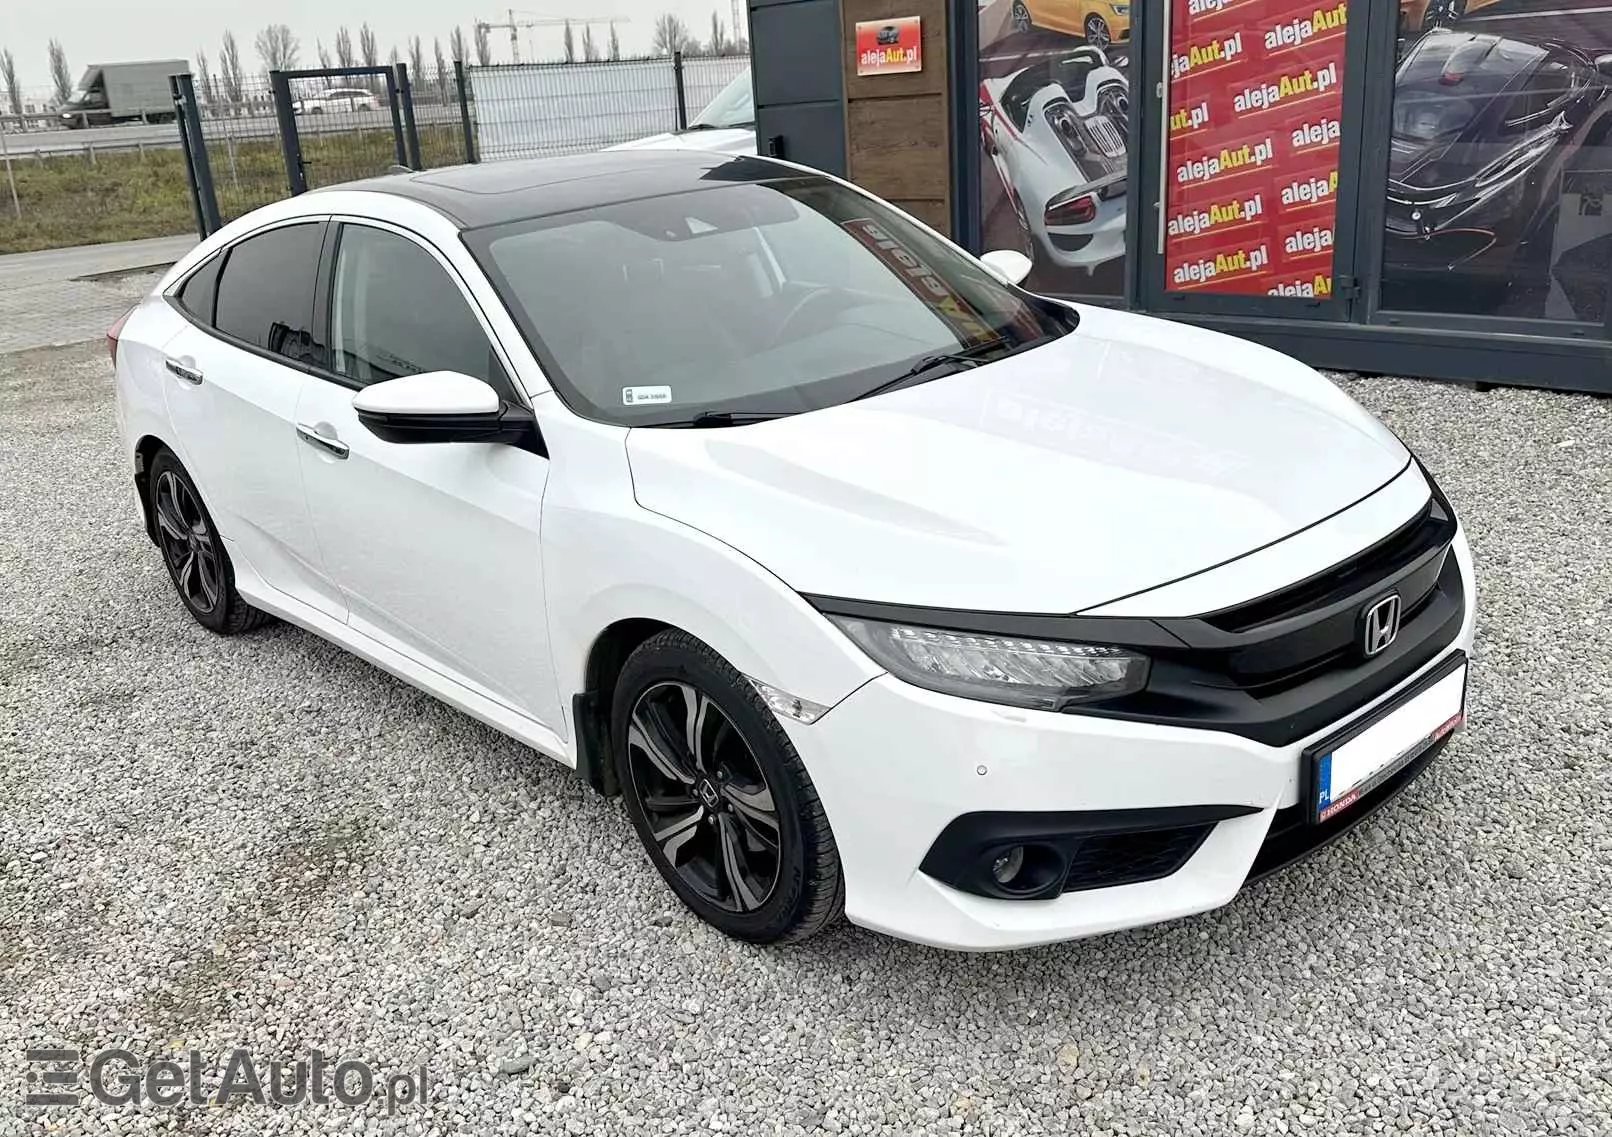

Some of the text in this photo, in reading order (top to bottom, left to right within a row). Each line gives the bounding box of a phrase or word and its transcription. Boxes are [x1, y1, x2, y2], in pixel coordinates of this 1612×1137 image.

[861, 46, 918, 67] alejaAut.pl
[1233, 63, 1337, 112] alejaAut.pl
[1291, 119, 1341, 147] aleja
[1176, 138, 1273, 182] alejaAut.pl
[1168, 195, 1263, 236] alejaAut.pl
[1173, 245, 1268, 284] alejaAut.pl
[1319, 789, 1329, 804] PL
